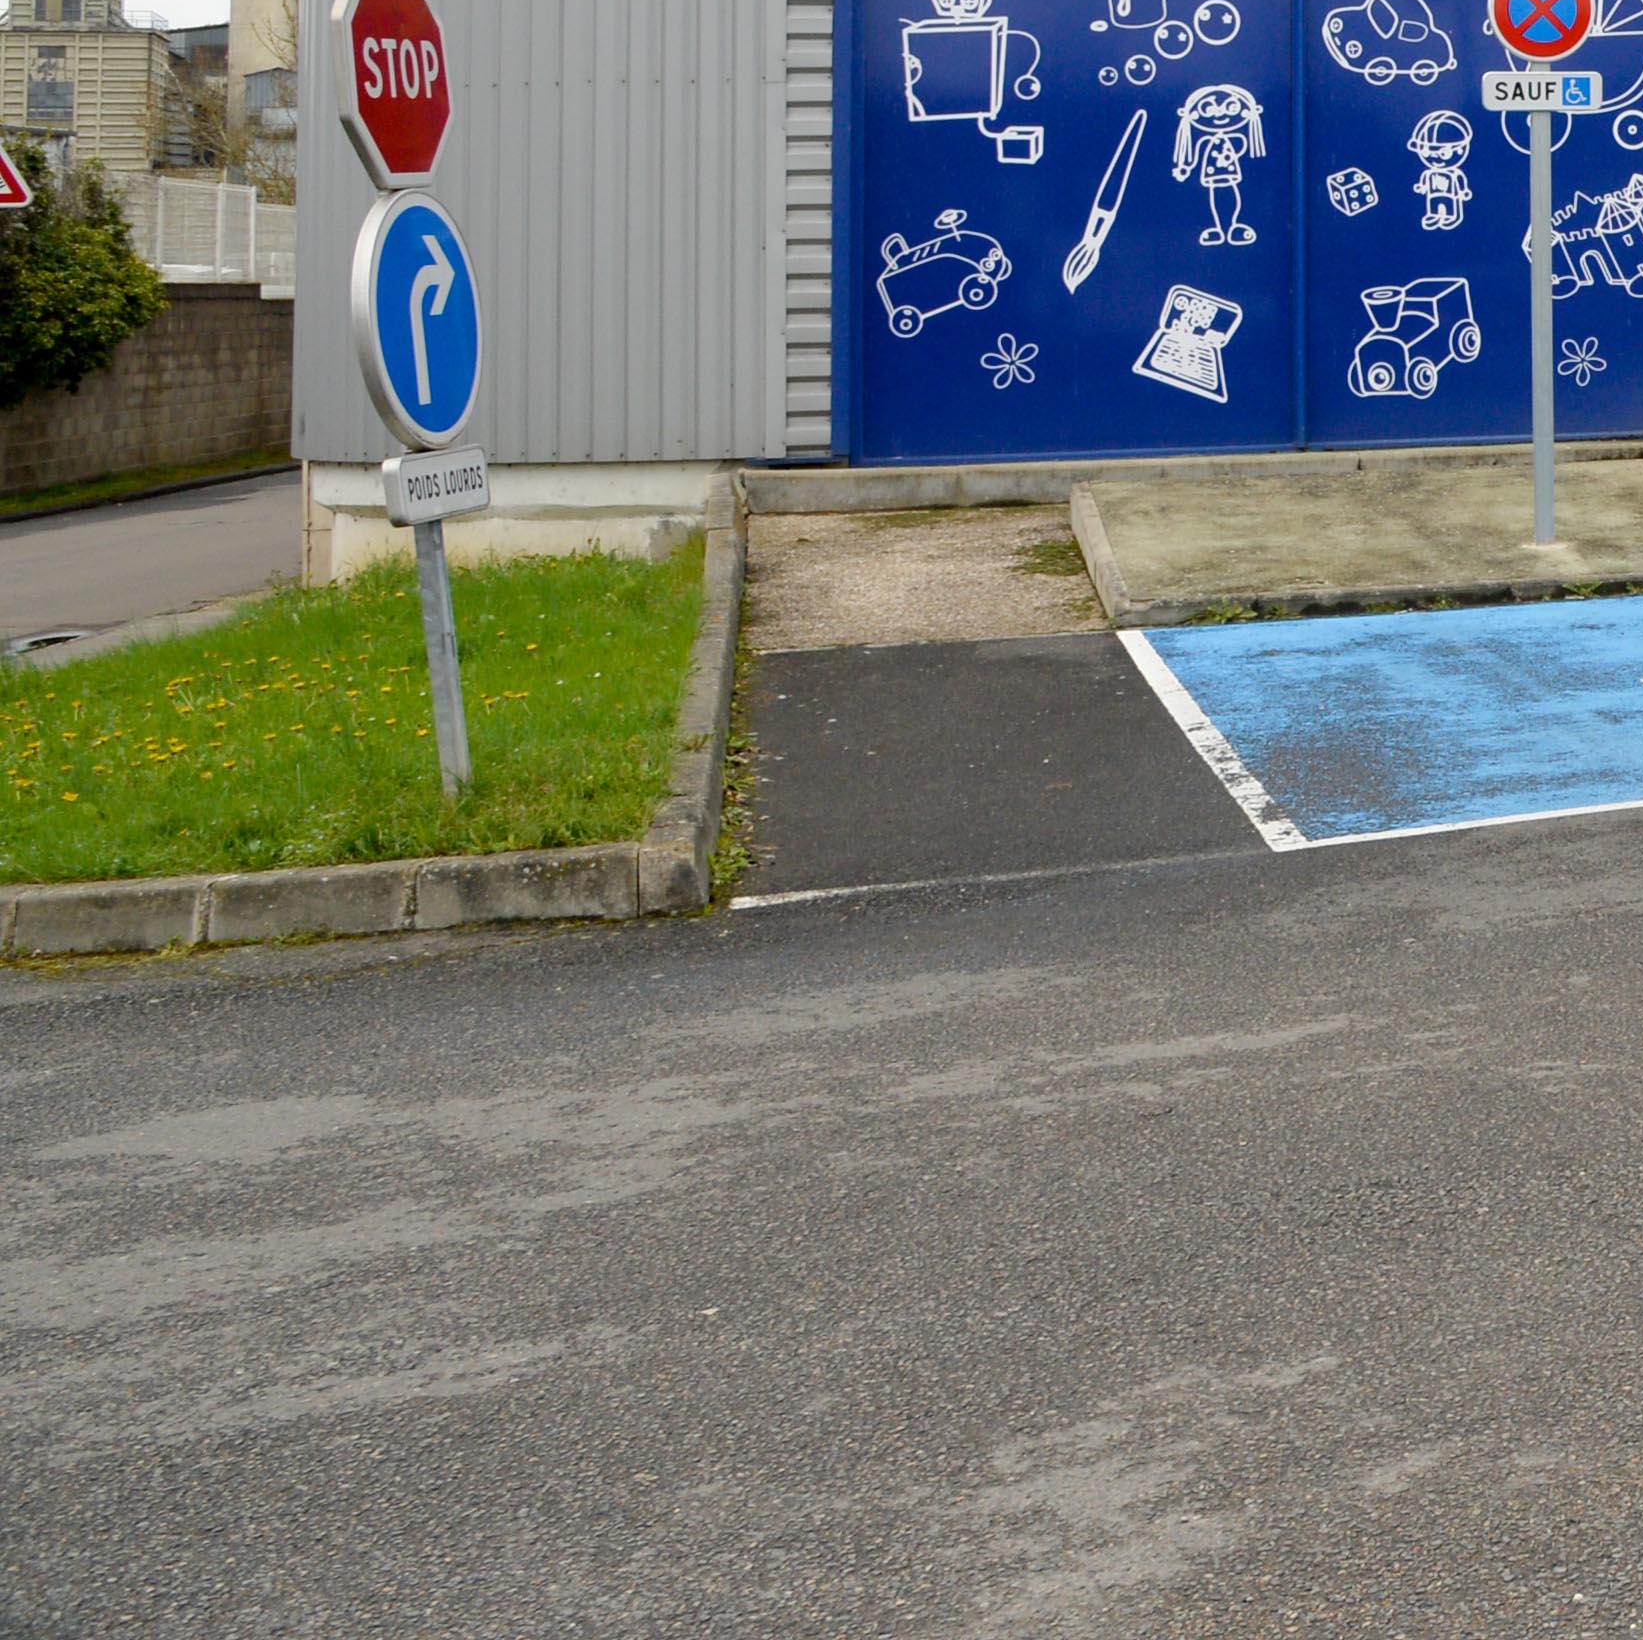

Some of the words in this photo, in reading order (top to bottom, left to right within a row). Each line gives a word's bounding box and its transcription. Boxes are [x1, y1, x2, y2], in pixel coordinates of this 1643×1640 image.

[363, 37, 439, 99] STOP
[1495, 81, 1556, 101] SAUF
[408, 474, 440, 502] POIDS
[444, 466, 483, 495] LOURDS
